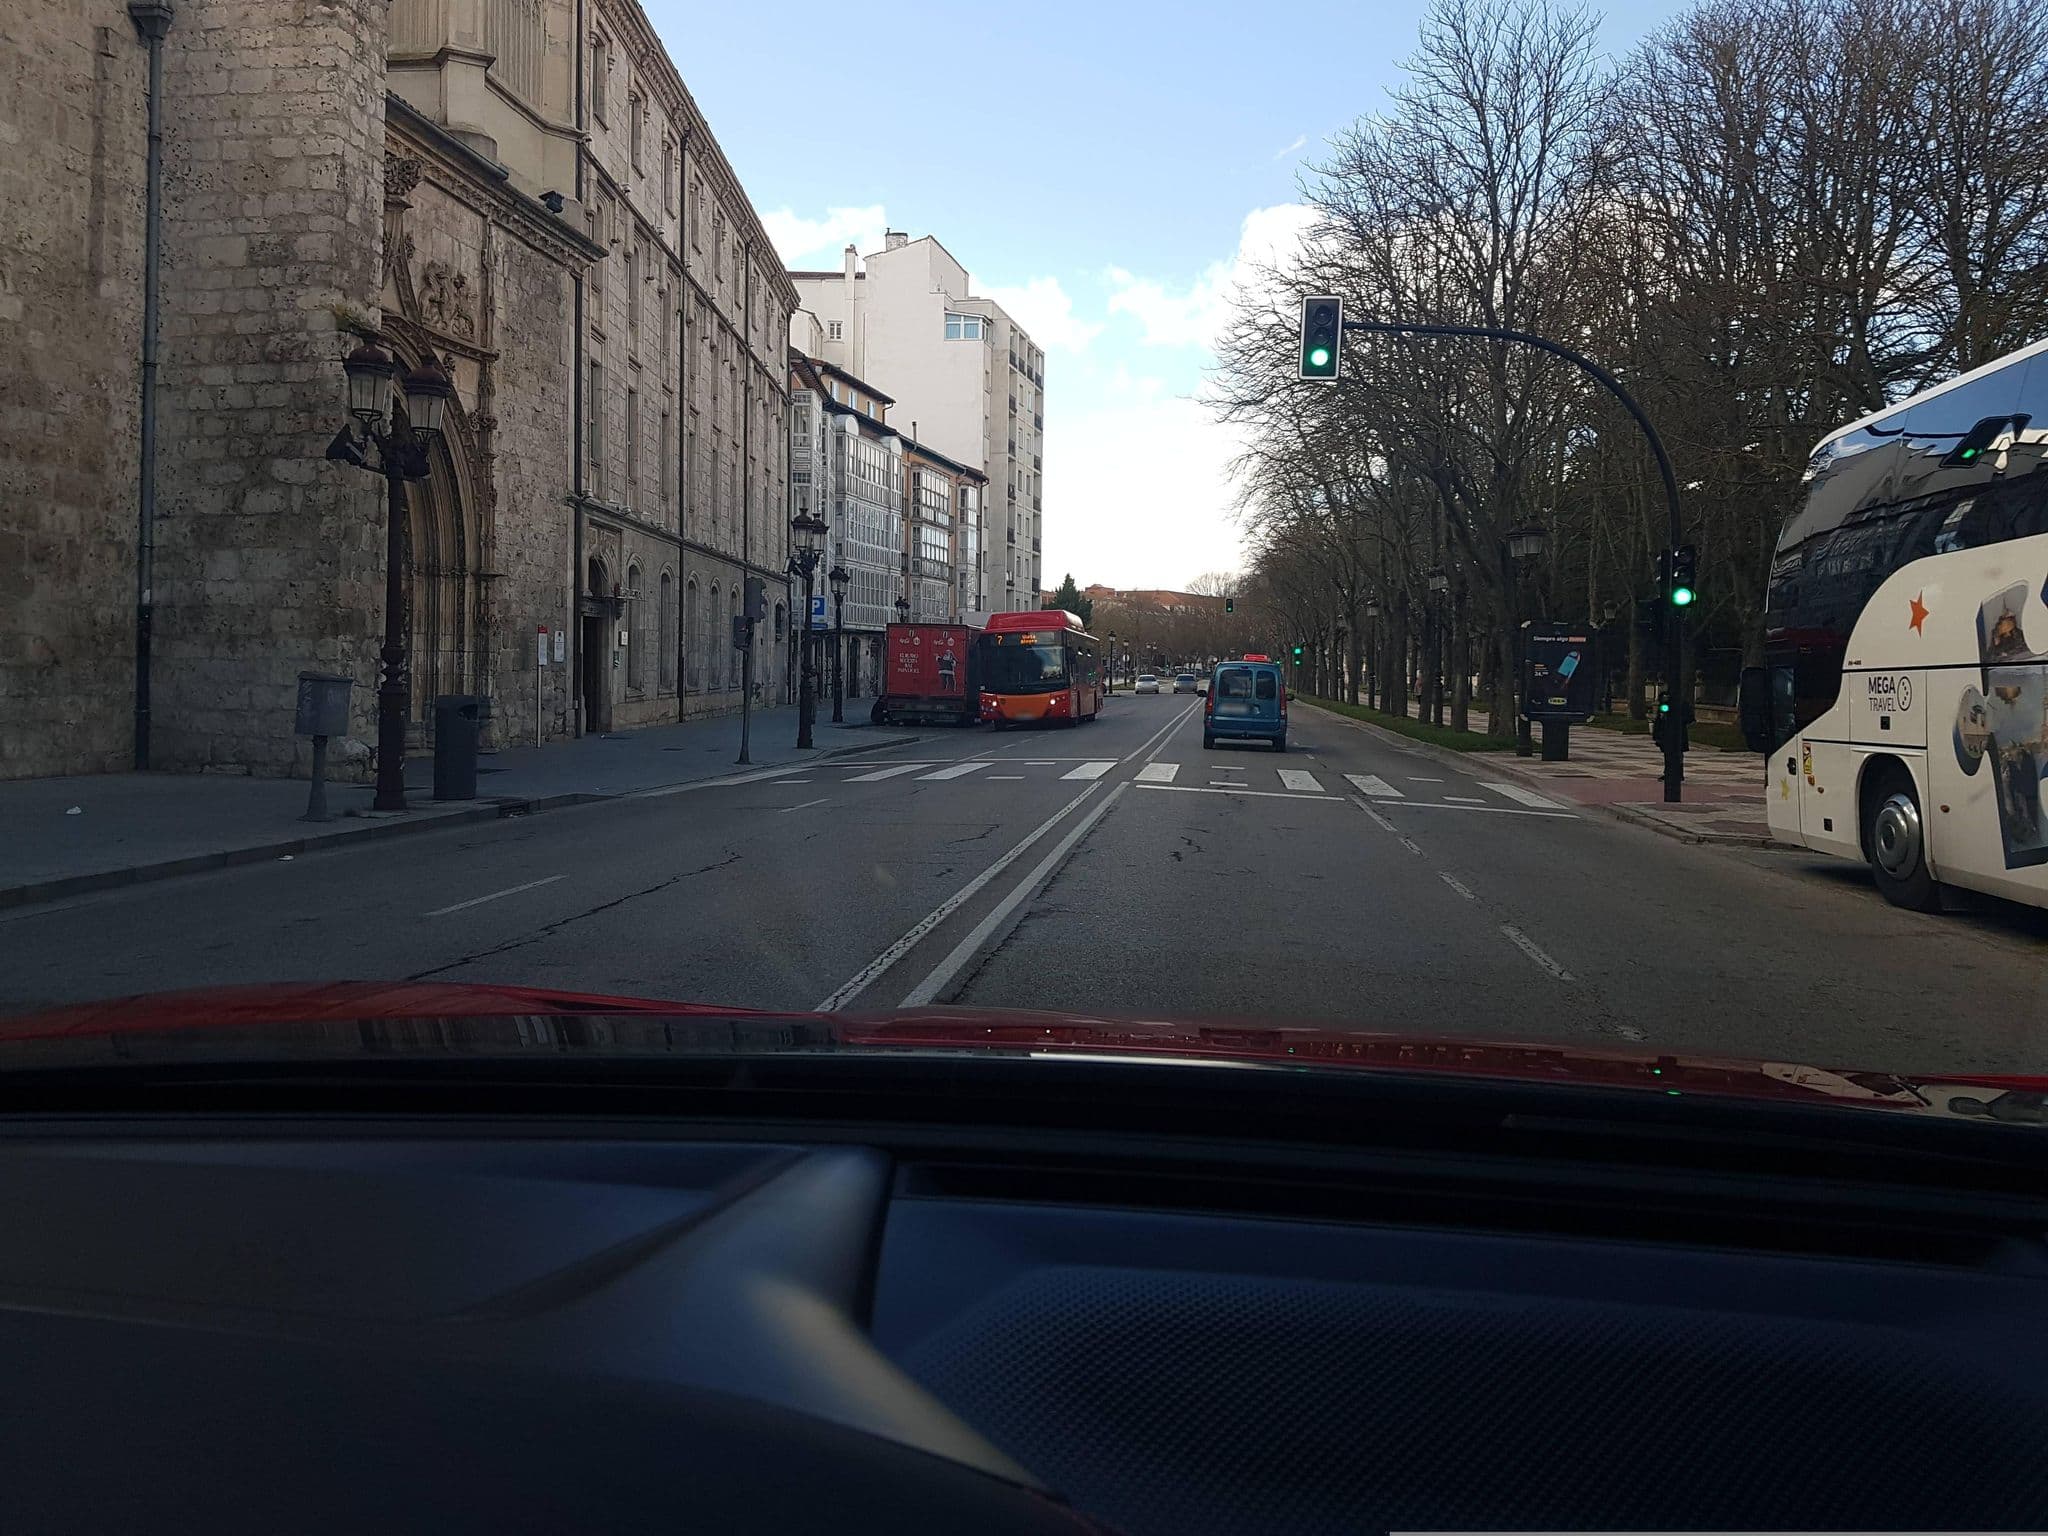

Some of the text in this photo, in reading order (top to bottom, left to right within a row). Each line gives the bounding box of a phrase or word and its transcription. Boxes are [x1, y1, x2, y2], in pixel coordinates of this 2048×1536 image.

[812, 599, 821, 613] P
[997, 635, 1003, 646] 7
[1868, 676, 1896, 694] MEGA
[1868, 697, 1897, 712] TRAVEL
